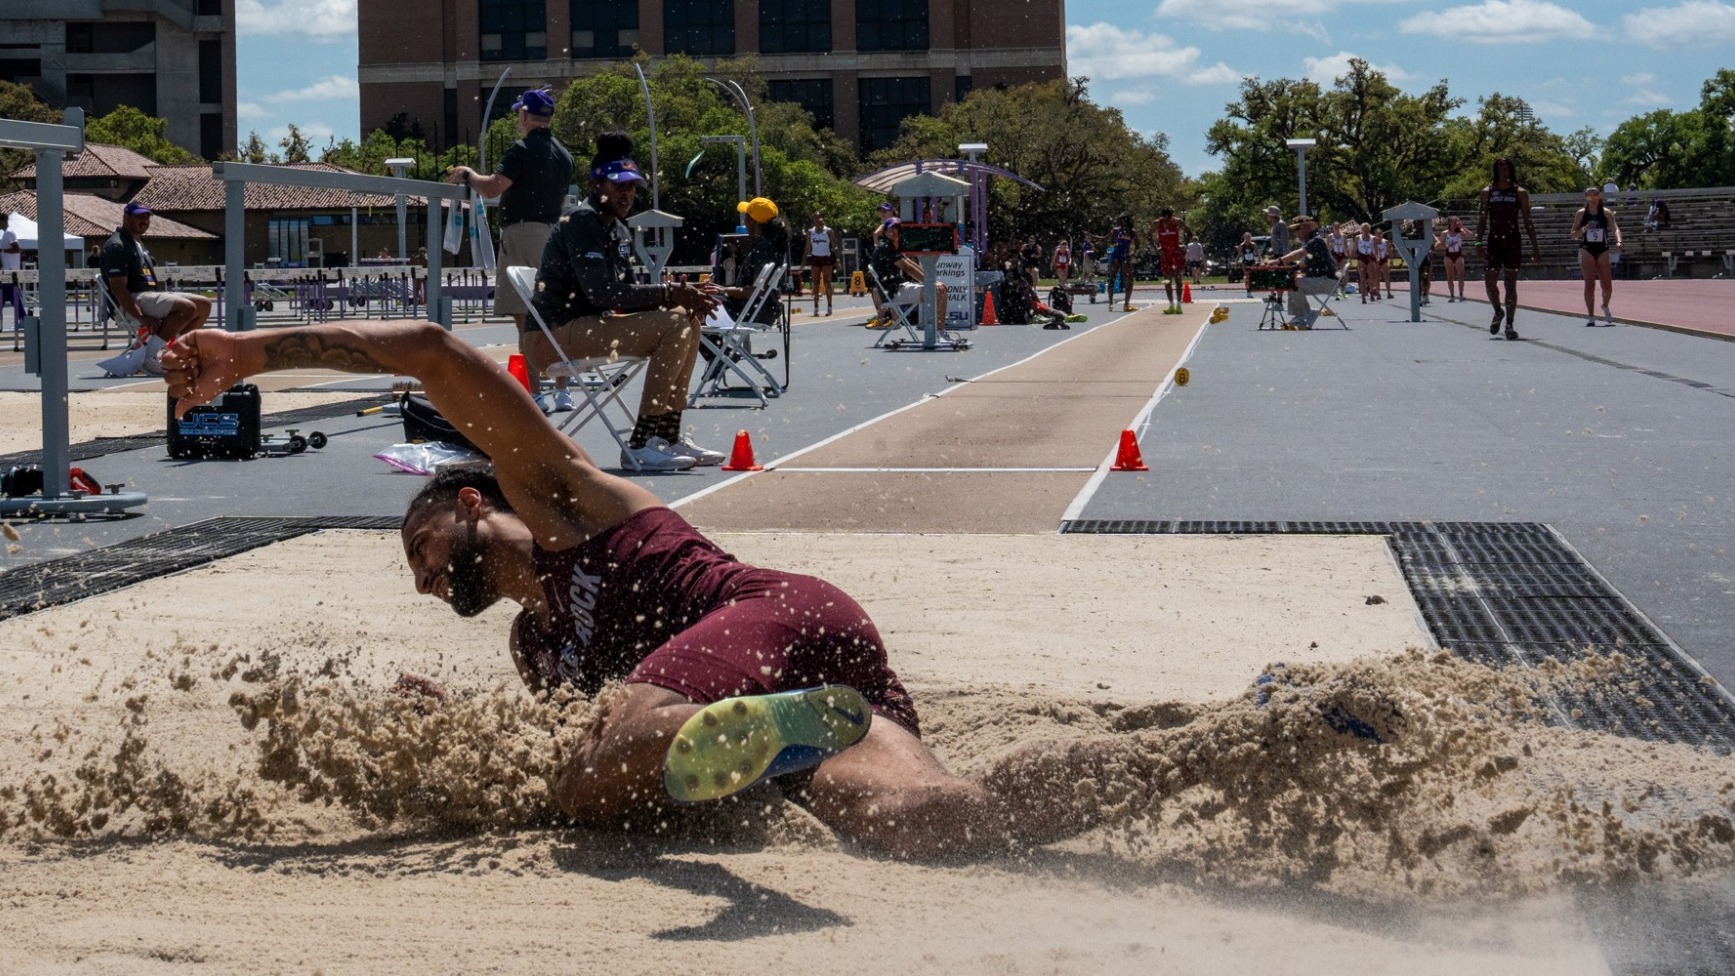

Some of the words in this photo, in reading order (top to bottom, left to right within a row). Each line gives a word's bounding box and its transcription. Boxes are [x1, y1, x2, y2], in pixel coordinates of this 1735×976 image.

[854, 275, 861, 286] 8
[944, 311, 969, 321] SU
[570, 563, 602, 649] ROCK
